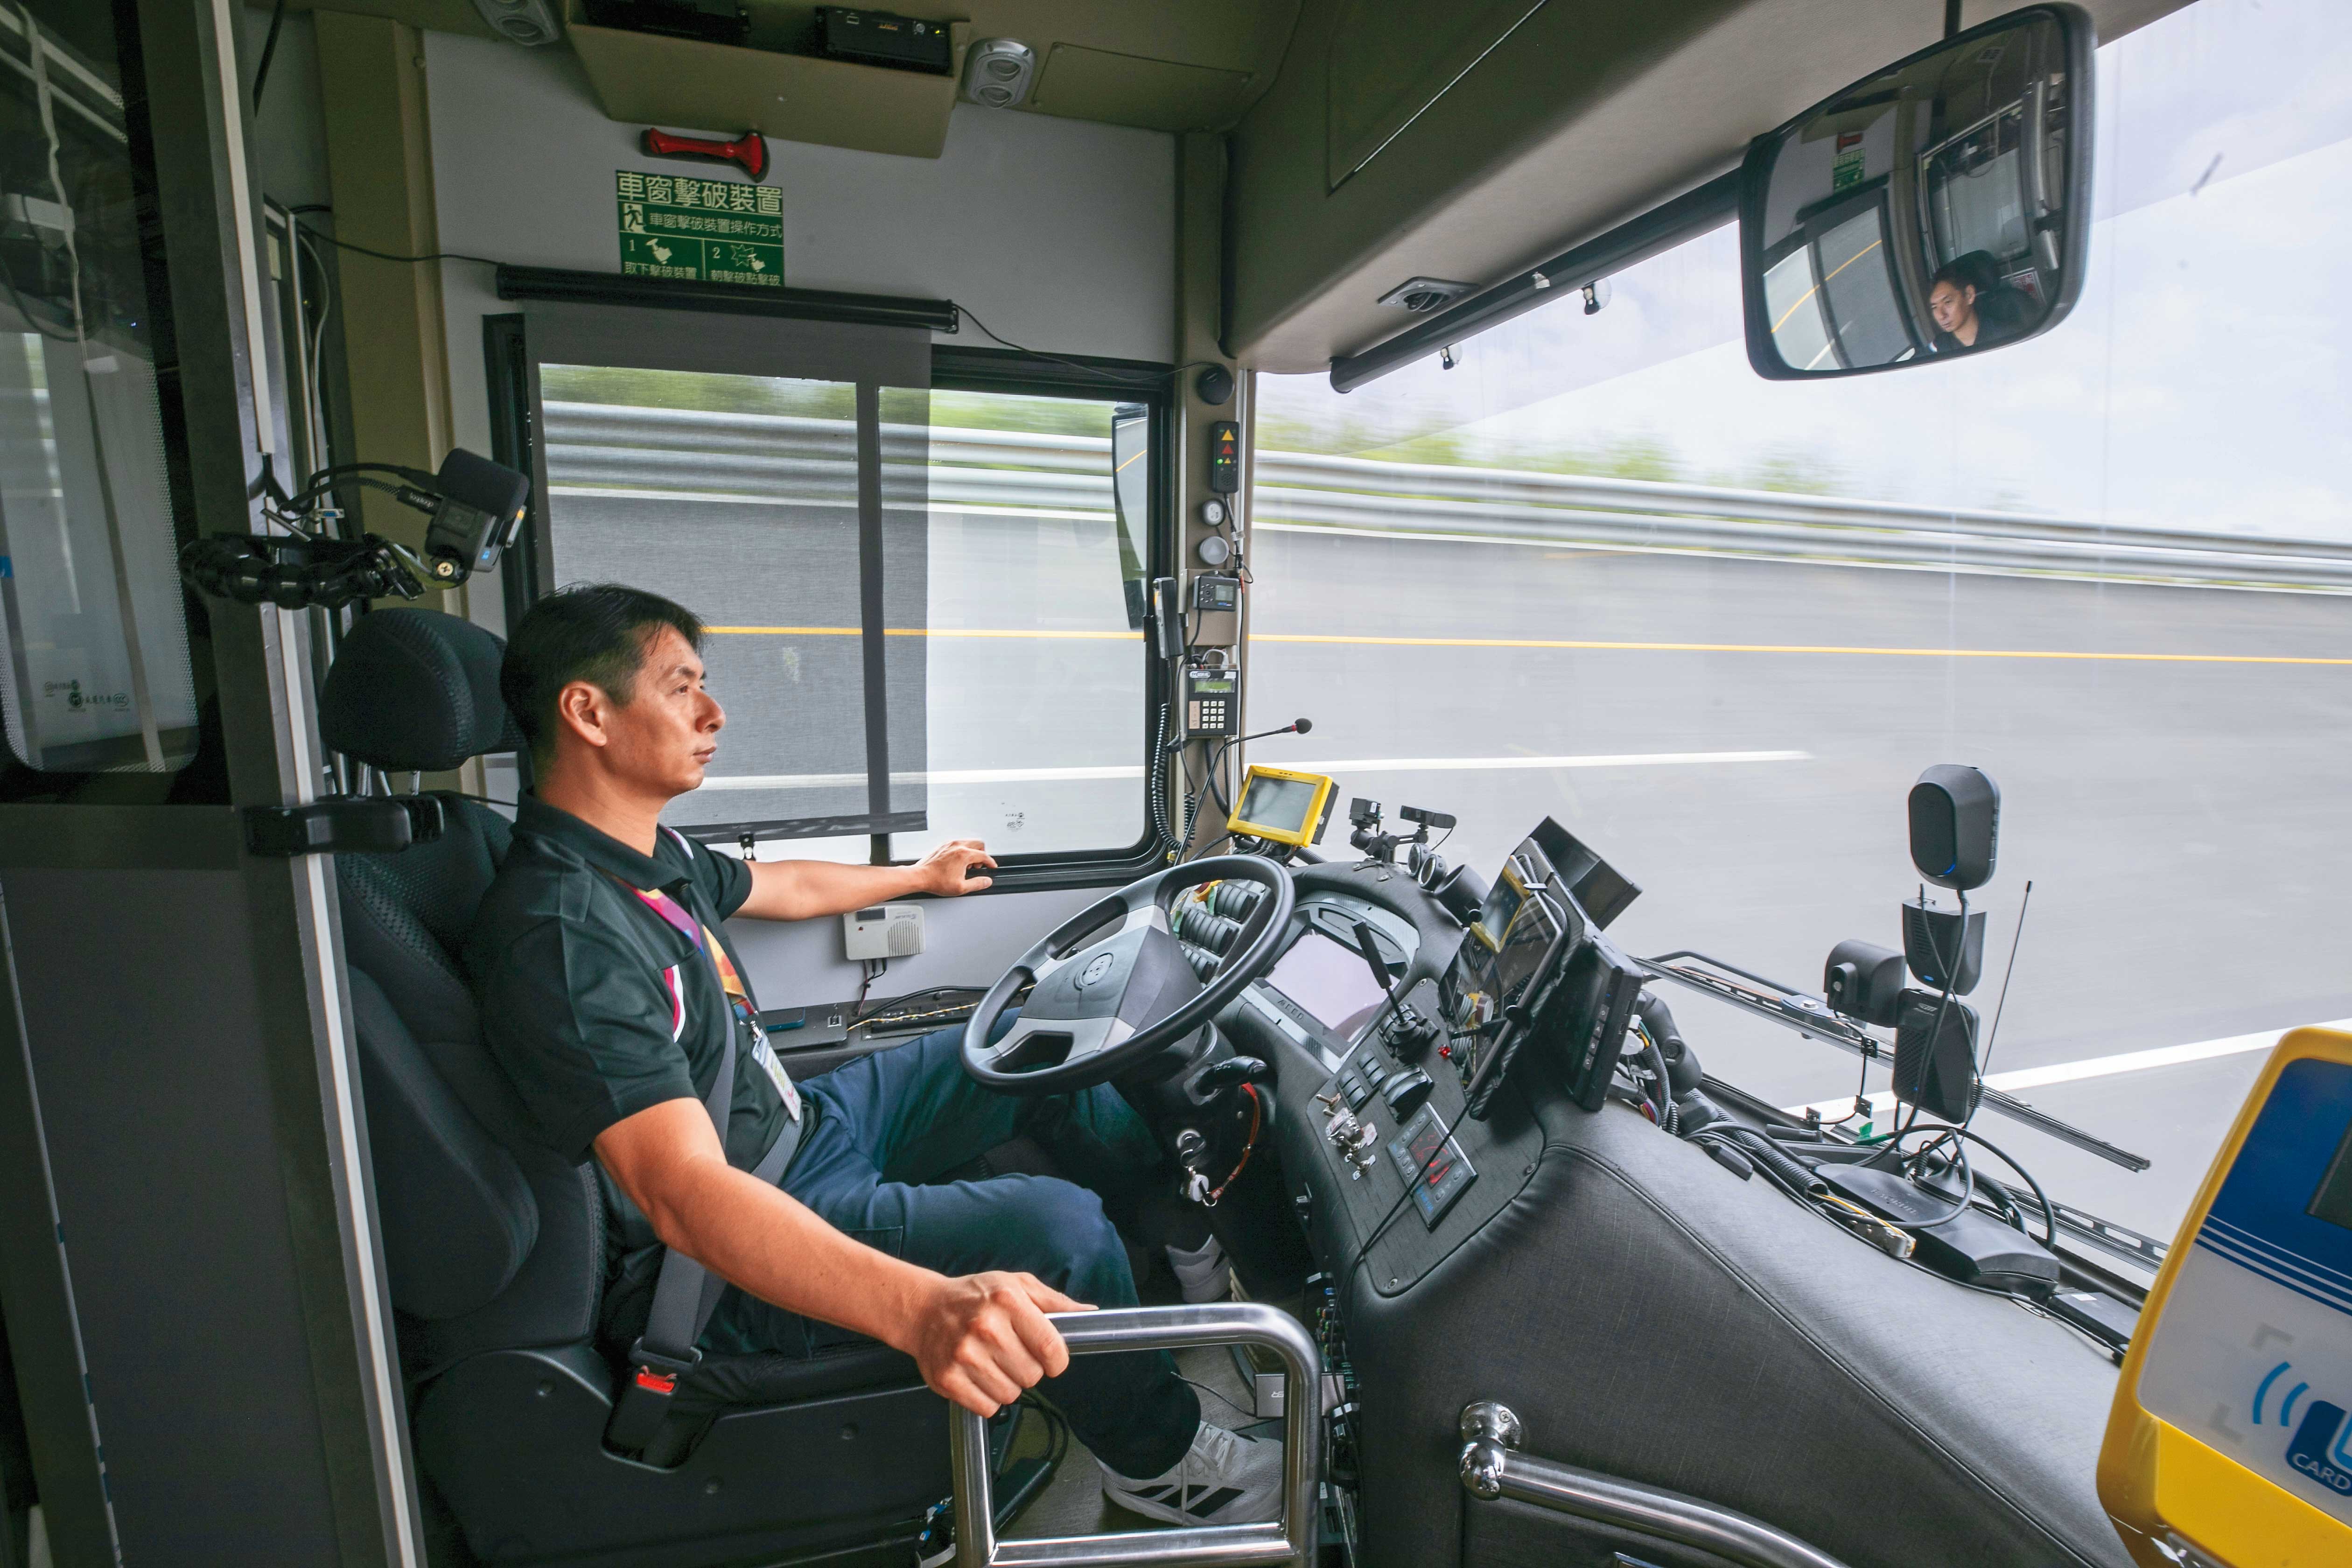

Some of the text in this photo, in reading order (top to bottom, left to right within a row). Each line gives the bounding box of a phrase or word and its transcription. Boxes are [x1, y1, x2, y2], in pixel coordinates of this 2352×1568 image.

[617, 172, 783, 215] 車窗擊破裝置
[649, 213, 782, 238] 車窗擊破裝置操作方式
[630, 239, 635, 251] 1
[712, 247, 720, 259] 2
[2292, 1453, 2351, 1490] CARD
